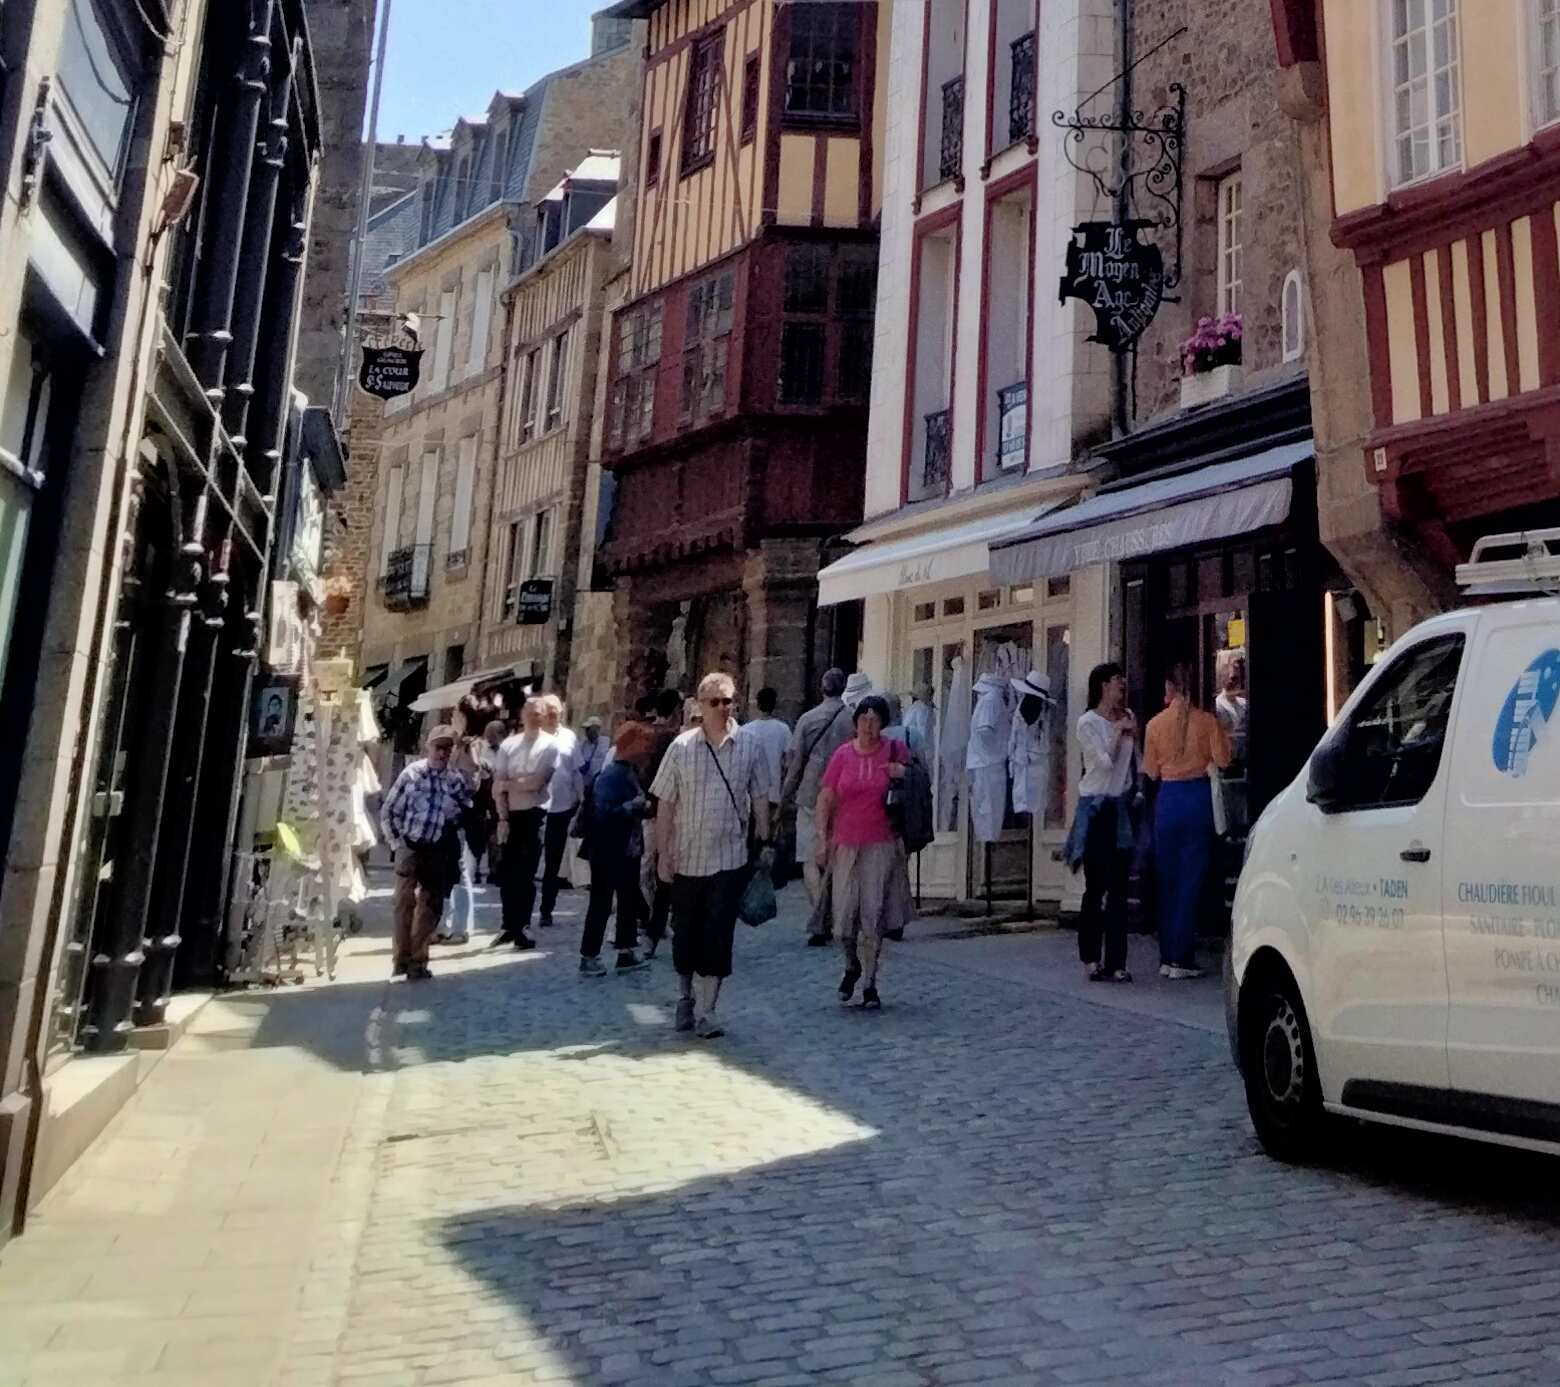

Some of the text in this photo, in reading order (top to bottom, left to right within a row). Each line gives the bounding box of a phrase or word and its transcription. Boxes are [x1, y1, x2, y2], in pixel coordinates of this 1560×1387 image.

[1103, 226, 1133, 259] Le
[1073, 250, 1140, 287] Moyen
[1091, 279, 1140, 315] Age
[1379, 878, 1409, 899] TADEN
[1458, 878, 1519, 905] CHAUDIÈRE
[1521, 884, 1557, 907] FIOUL
[1336, 903, 1348, 925] 02
[1469, 914, 1525, 938] SANITAIRE
[1494, 947, 1533, 972] POMPE
